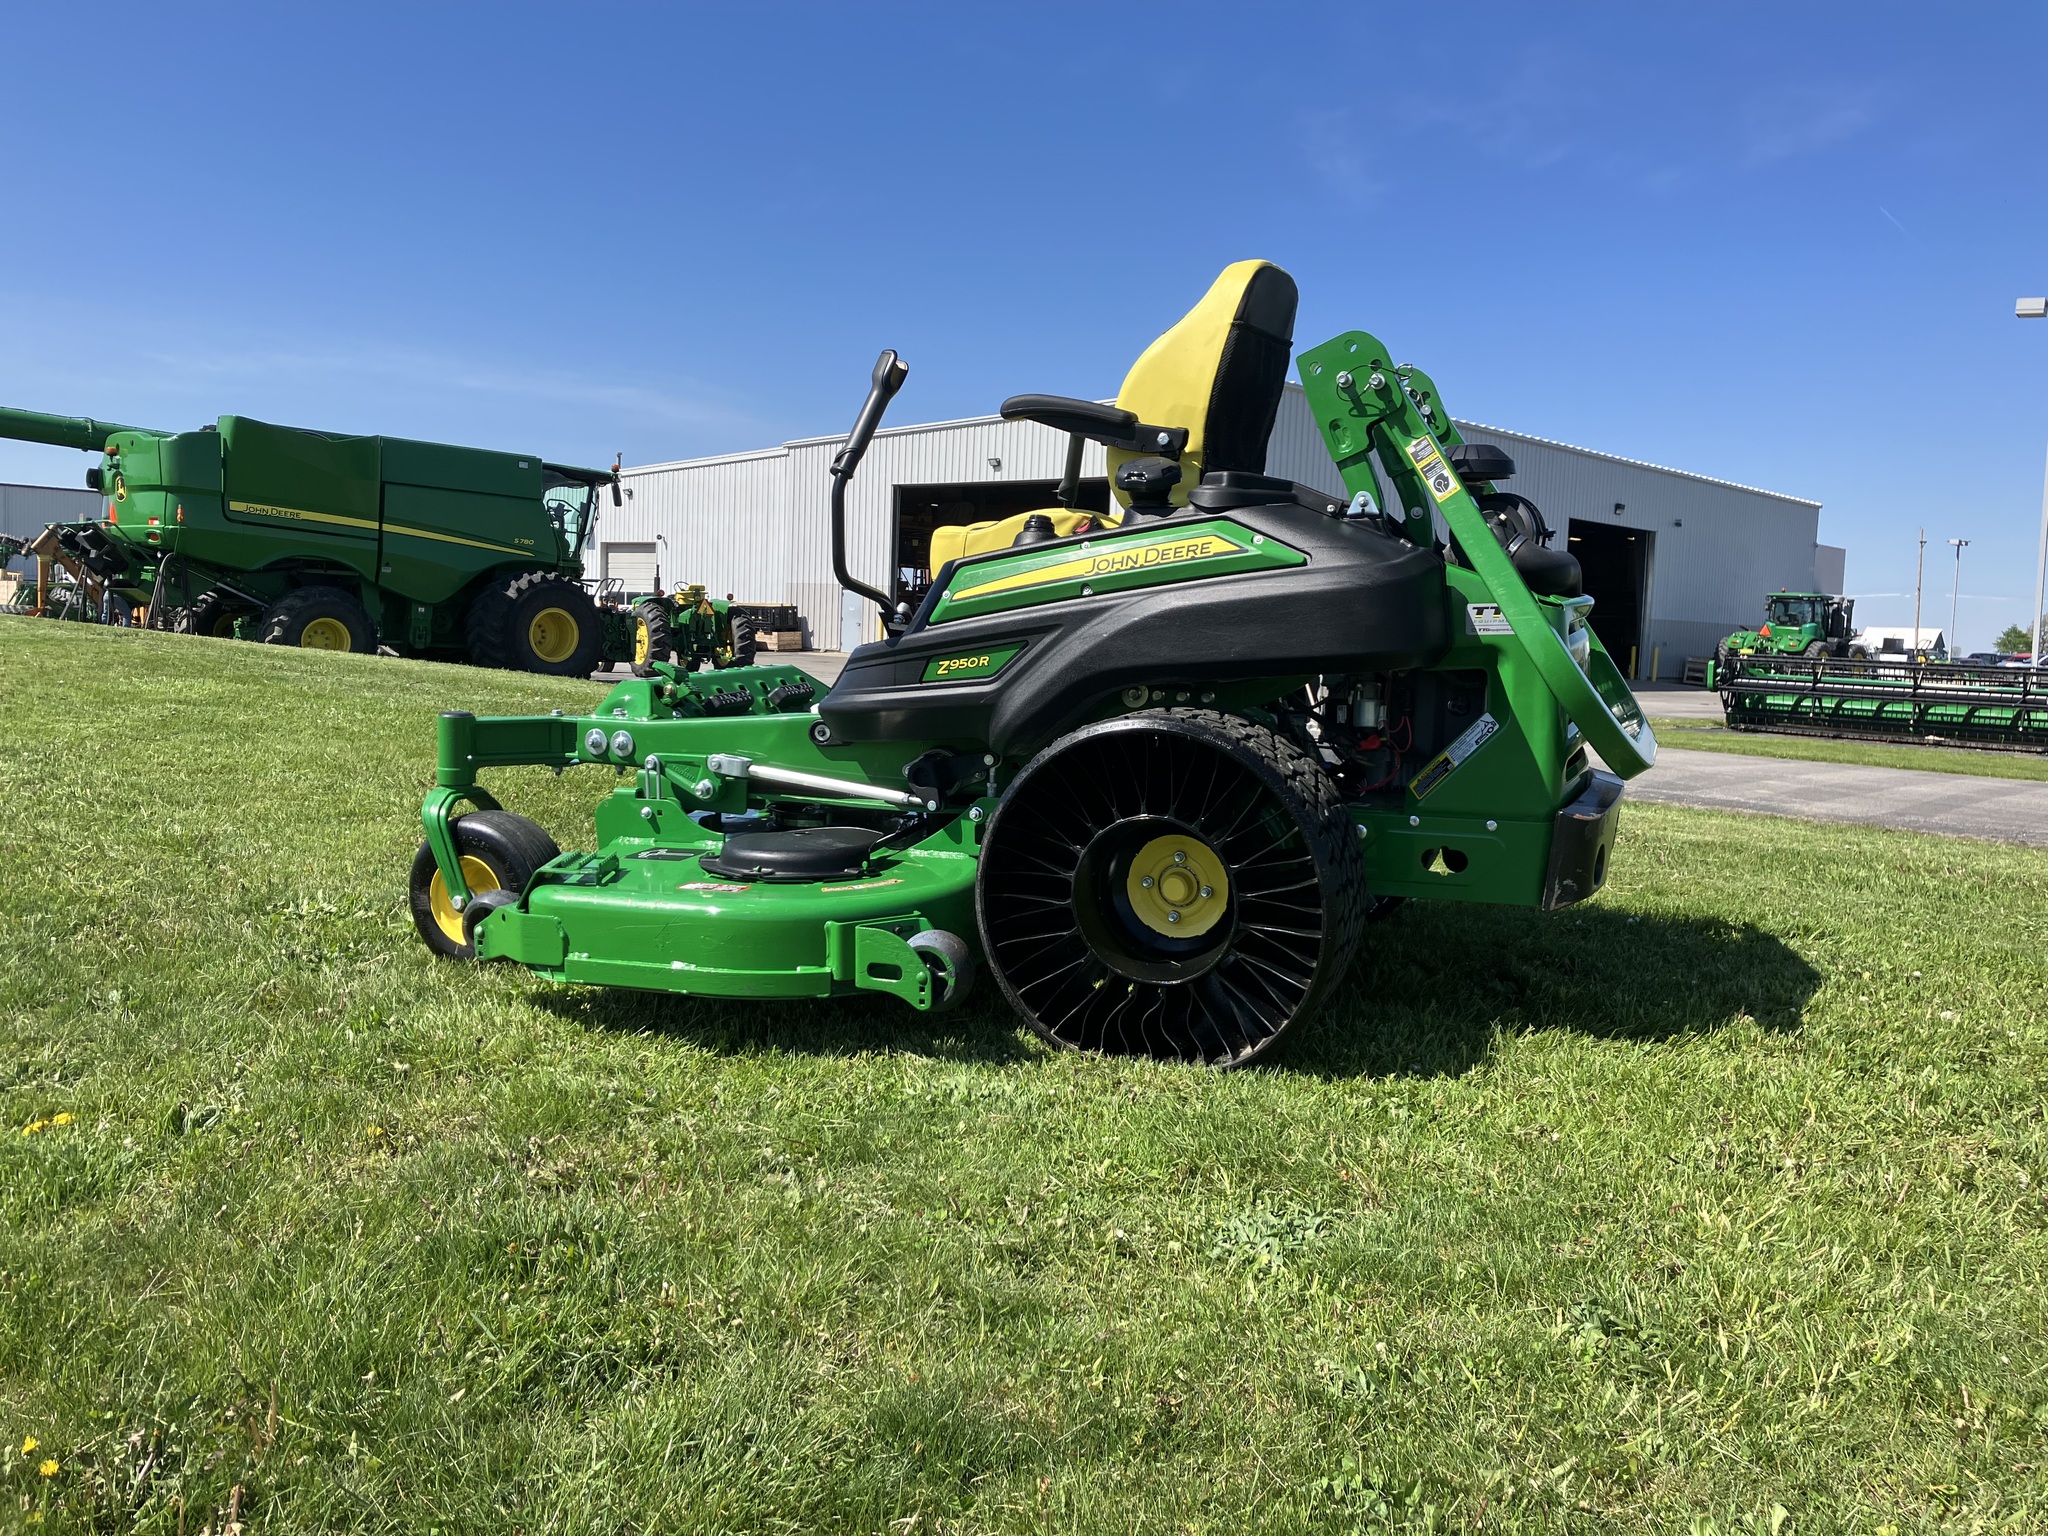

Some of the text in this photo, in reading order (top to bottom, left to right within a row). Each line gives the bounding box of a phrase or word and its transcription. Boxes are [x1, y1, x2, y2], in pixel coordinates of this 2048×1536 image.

[243, 504, 302, 519] JOHN DEERE
[1084, 541, 1213, 575] JOHN DEERE
[1472, 606, 1501, 619] TT
[936, 656, 990, 675] Z950R
